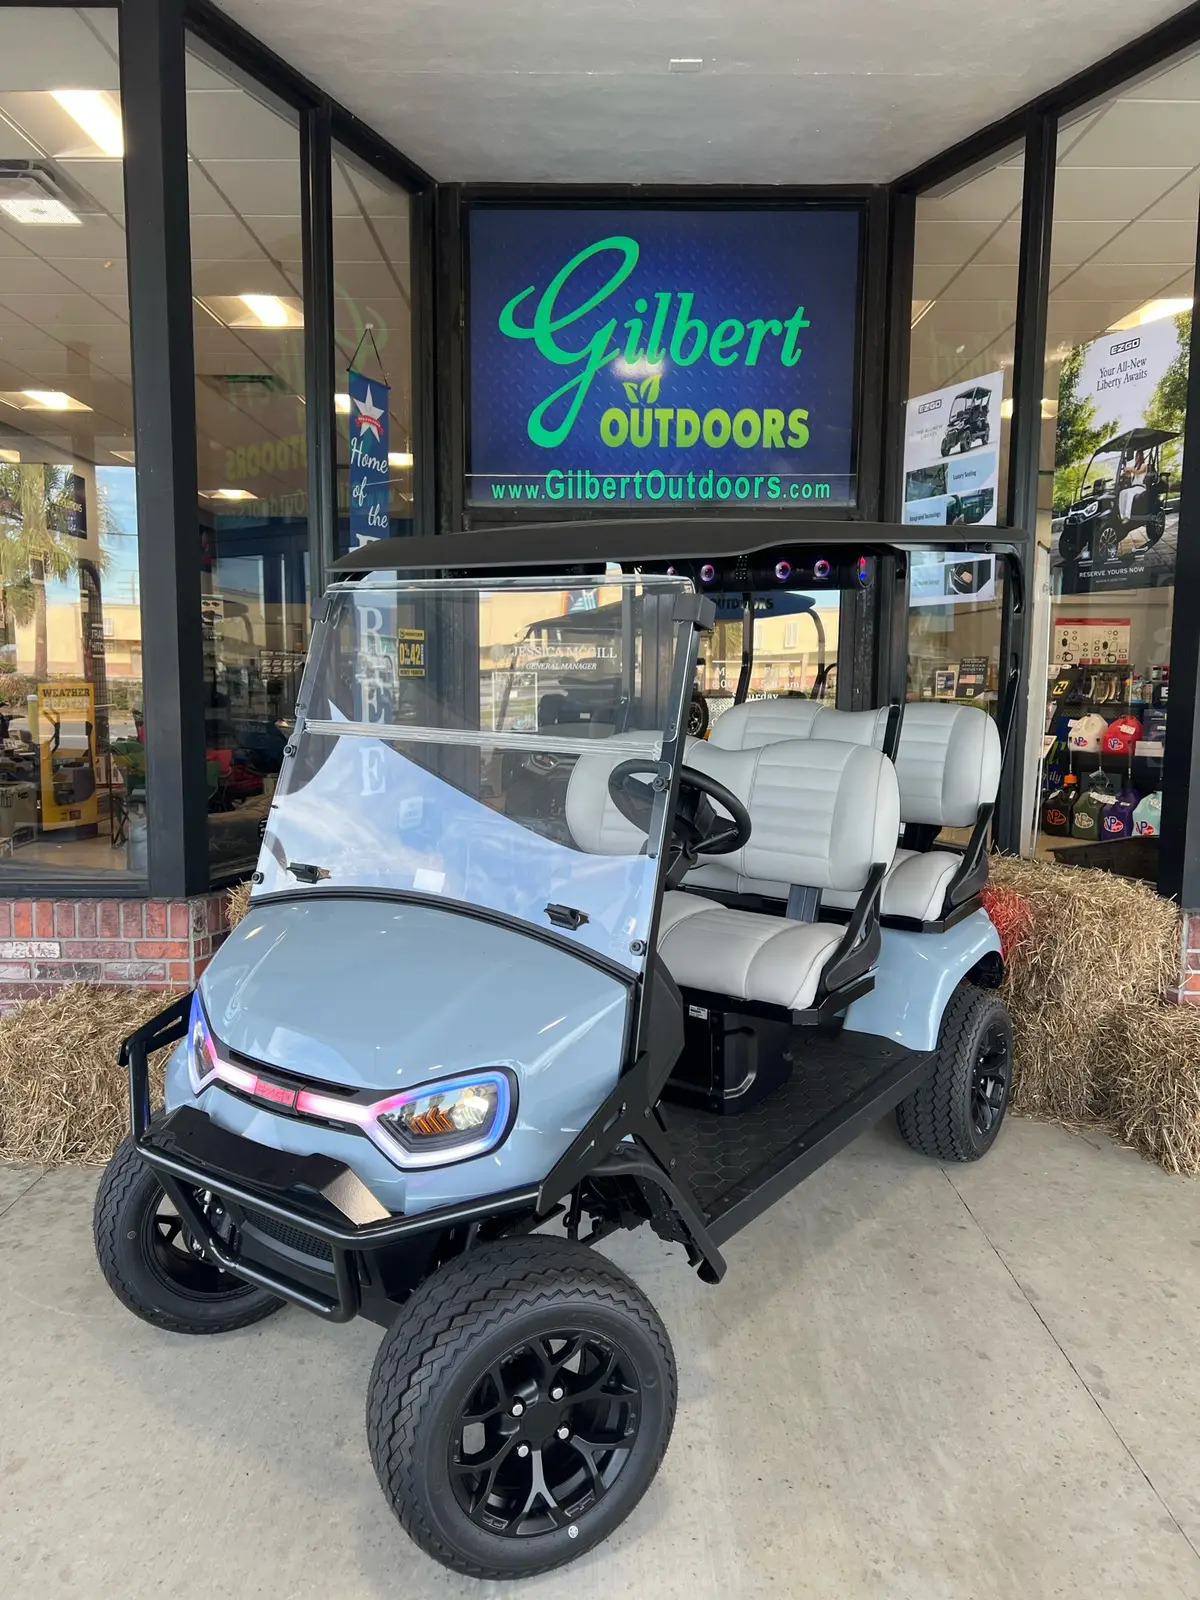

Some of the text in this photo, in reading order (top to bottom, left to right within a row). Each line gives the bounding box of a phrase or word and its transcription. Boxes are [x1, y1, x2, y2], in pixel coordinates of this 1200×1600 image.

[498, 236, 811, 448] Gilbert
[1110, 338, 1140, 355] EZGO
[1100, 358, 1147, 378] Your All-New
[1097, 369, 1148, 391] Liberty Awaits
[918, 399, 943, 414] EZGO
[600, 407, 810, 448] OUTDOORS
[350, 436, 389, 474] Home
[352, 476, 367, 507] of
[491, 469, 831, 501] www.GilbertOutdoors.com
[368, 503, 389, 529] the
[1079, 566, 1145, 578] RESERVE YOURS NOW
[511, 646, 561, 657] JESSICA
[525, 662, 598, 670] GENERAL MANAGER
[42, 687, 90, 697] WEATHER
[732, 691, 779, 701] Surday
